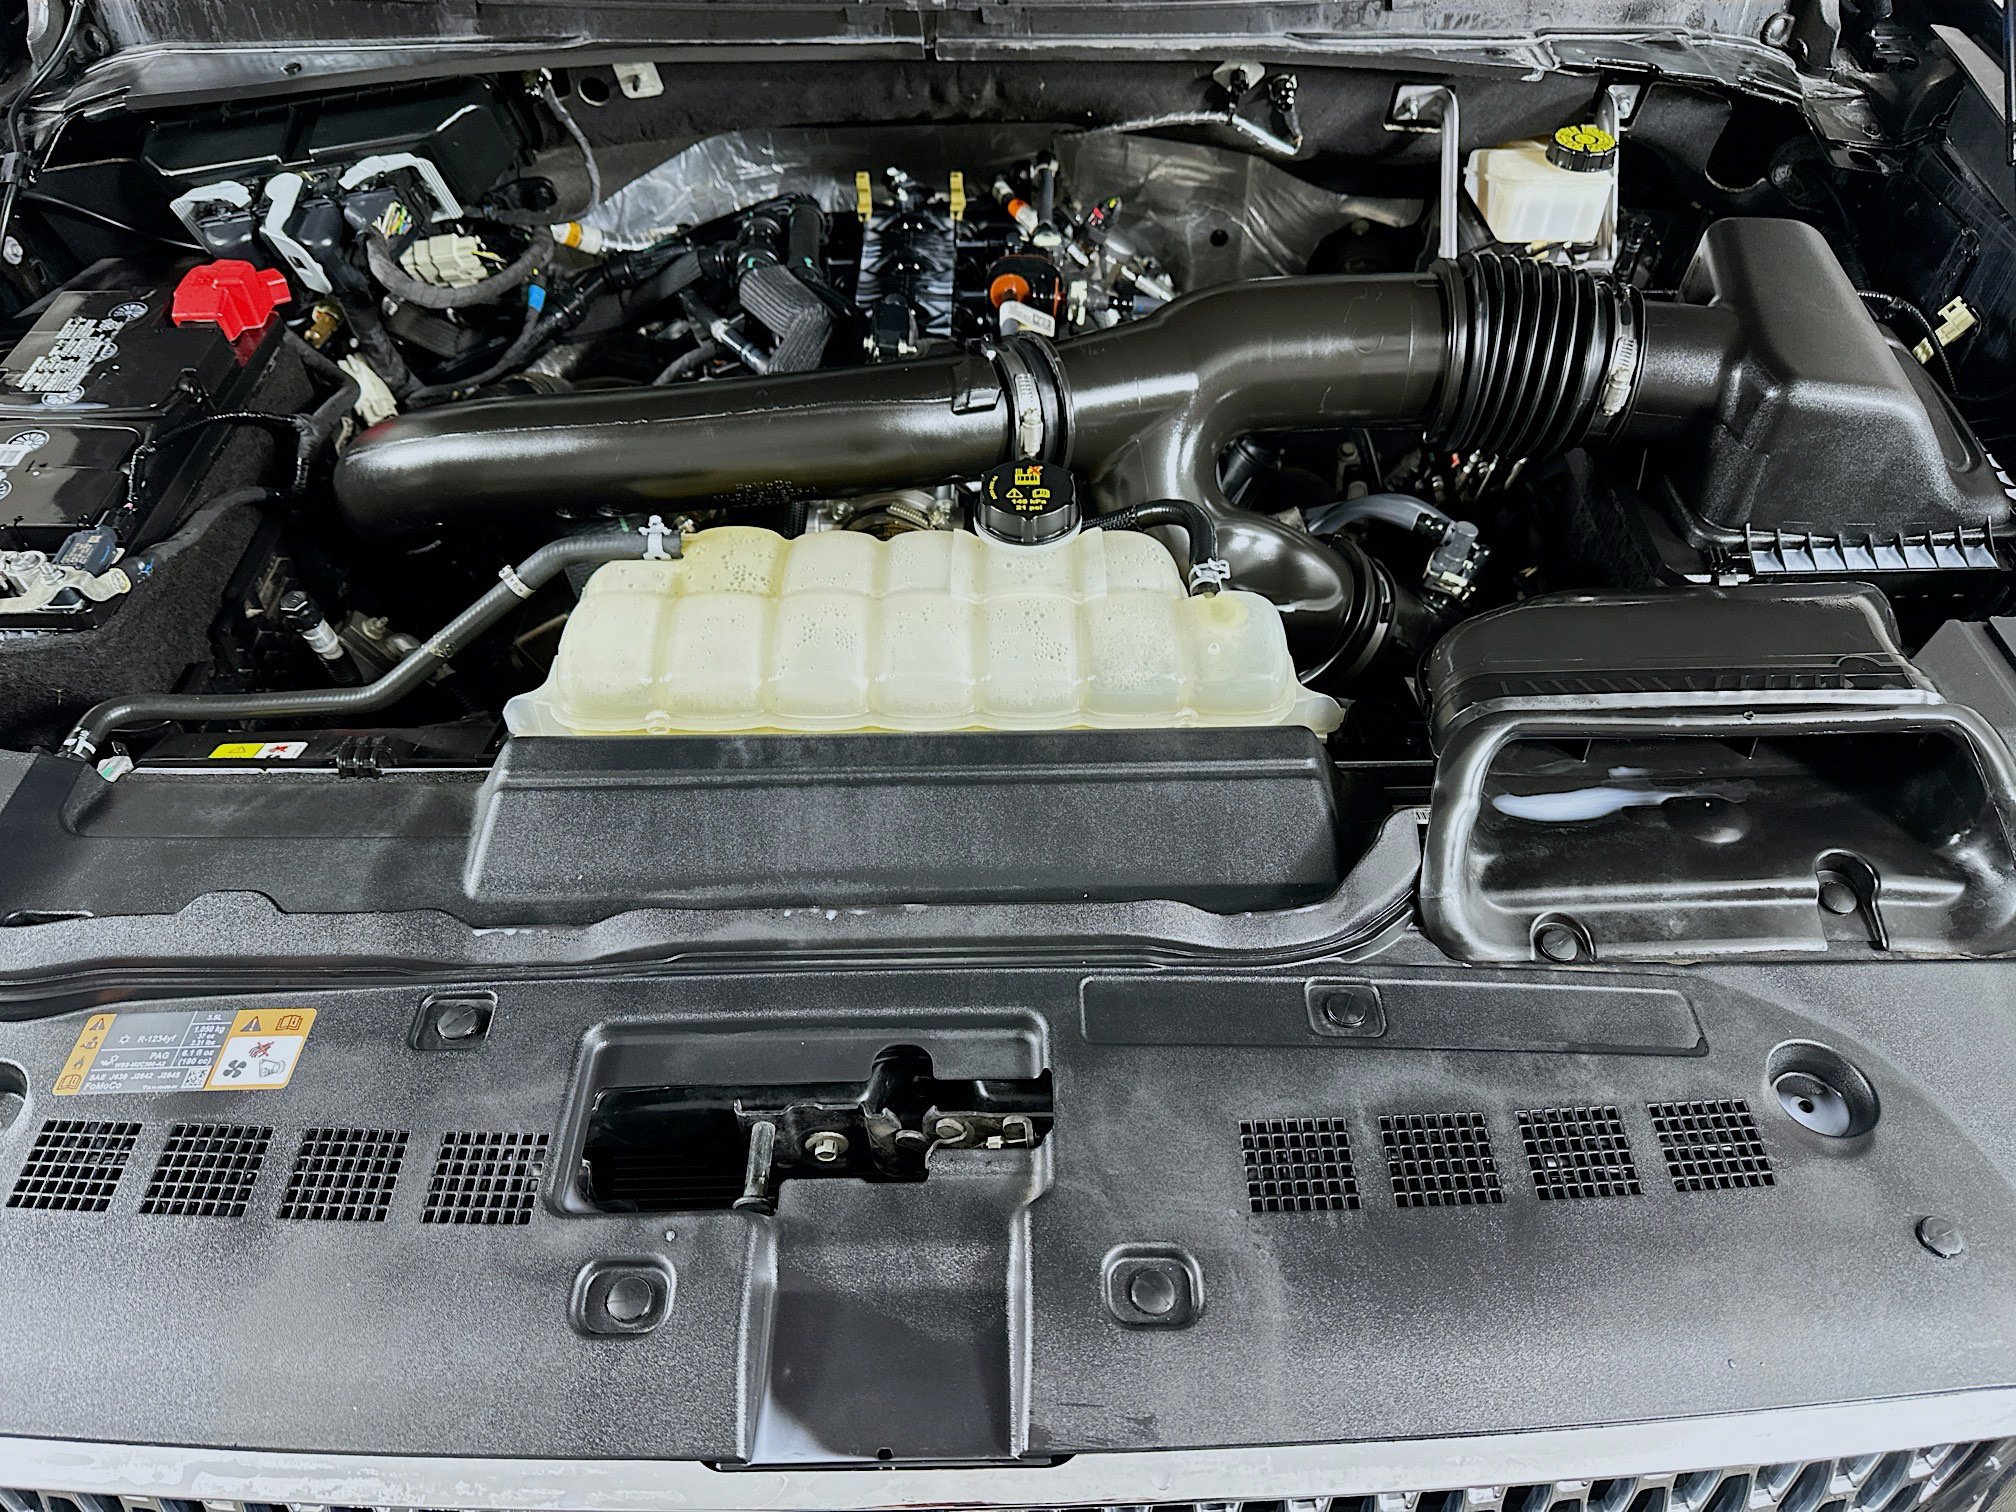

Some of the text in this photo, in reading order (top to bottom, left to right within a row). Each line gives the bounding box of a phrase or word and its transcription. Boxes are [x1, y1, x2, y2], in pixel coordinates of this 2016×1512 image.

[1028, 504, 1043, 512] psi
[194, 1025, 226, 1035] 1.050 kg
[137, 1034, 177, 1045] R-1234yf
[149, 1052, 170, 1060] PAG
[181, 1049, 195, 1057] 6.1
[178, 1057, 212, 1066] (180 cc)
[88, 1073, 106, 1082] SAE
[83, 1081, 123, 1091] FoMoCo
